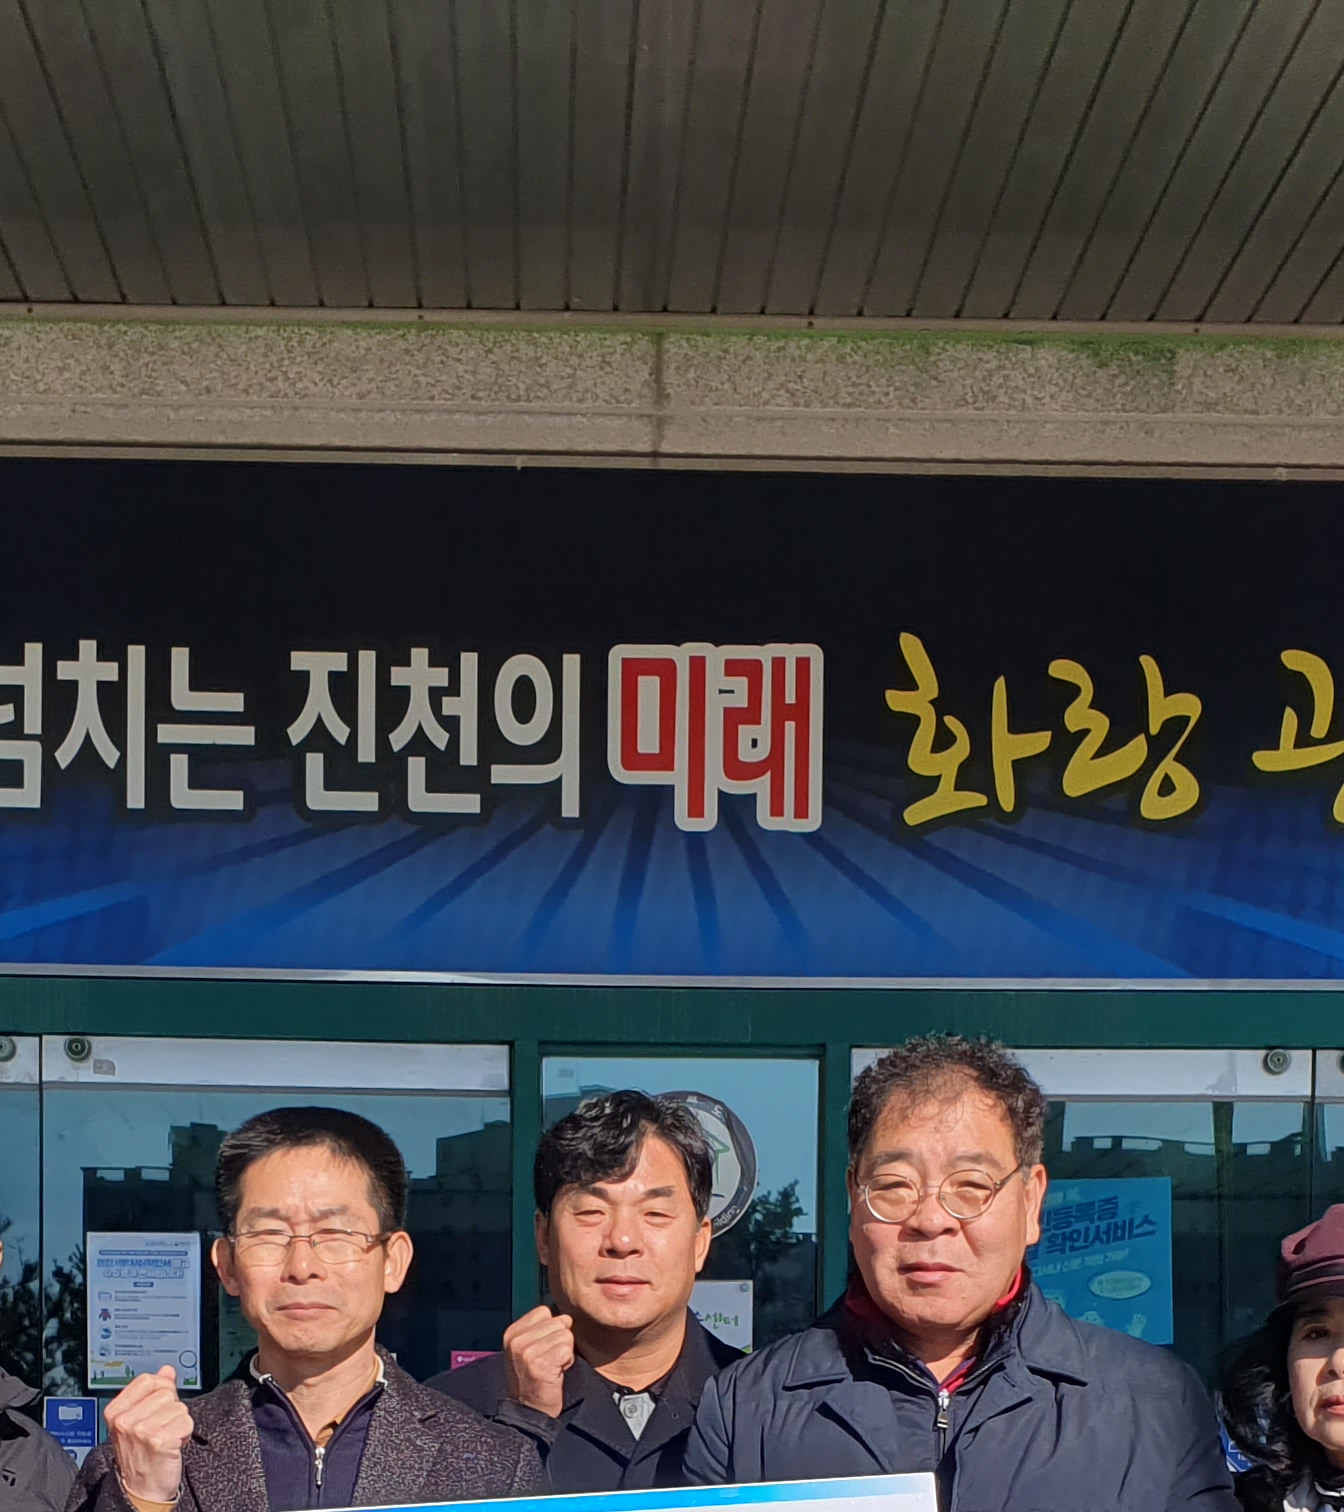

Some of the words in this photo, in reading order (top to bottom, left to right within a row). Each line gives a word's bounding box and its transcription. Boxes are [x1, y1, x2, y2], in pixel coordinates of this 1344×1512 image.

[287, 645, 581, 819] 진천의
[608, 643, 822, 832] 미래
[885, 631, 1202, 826] 화랑
